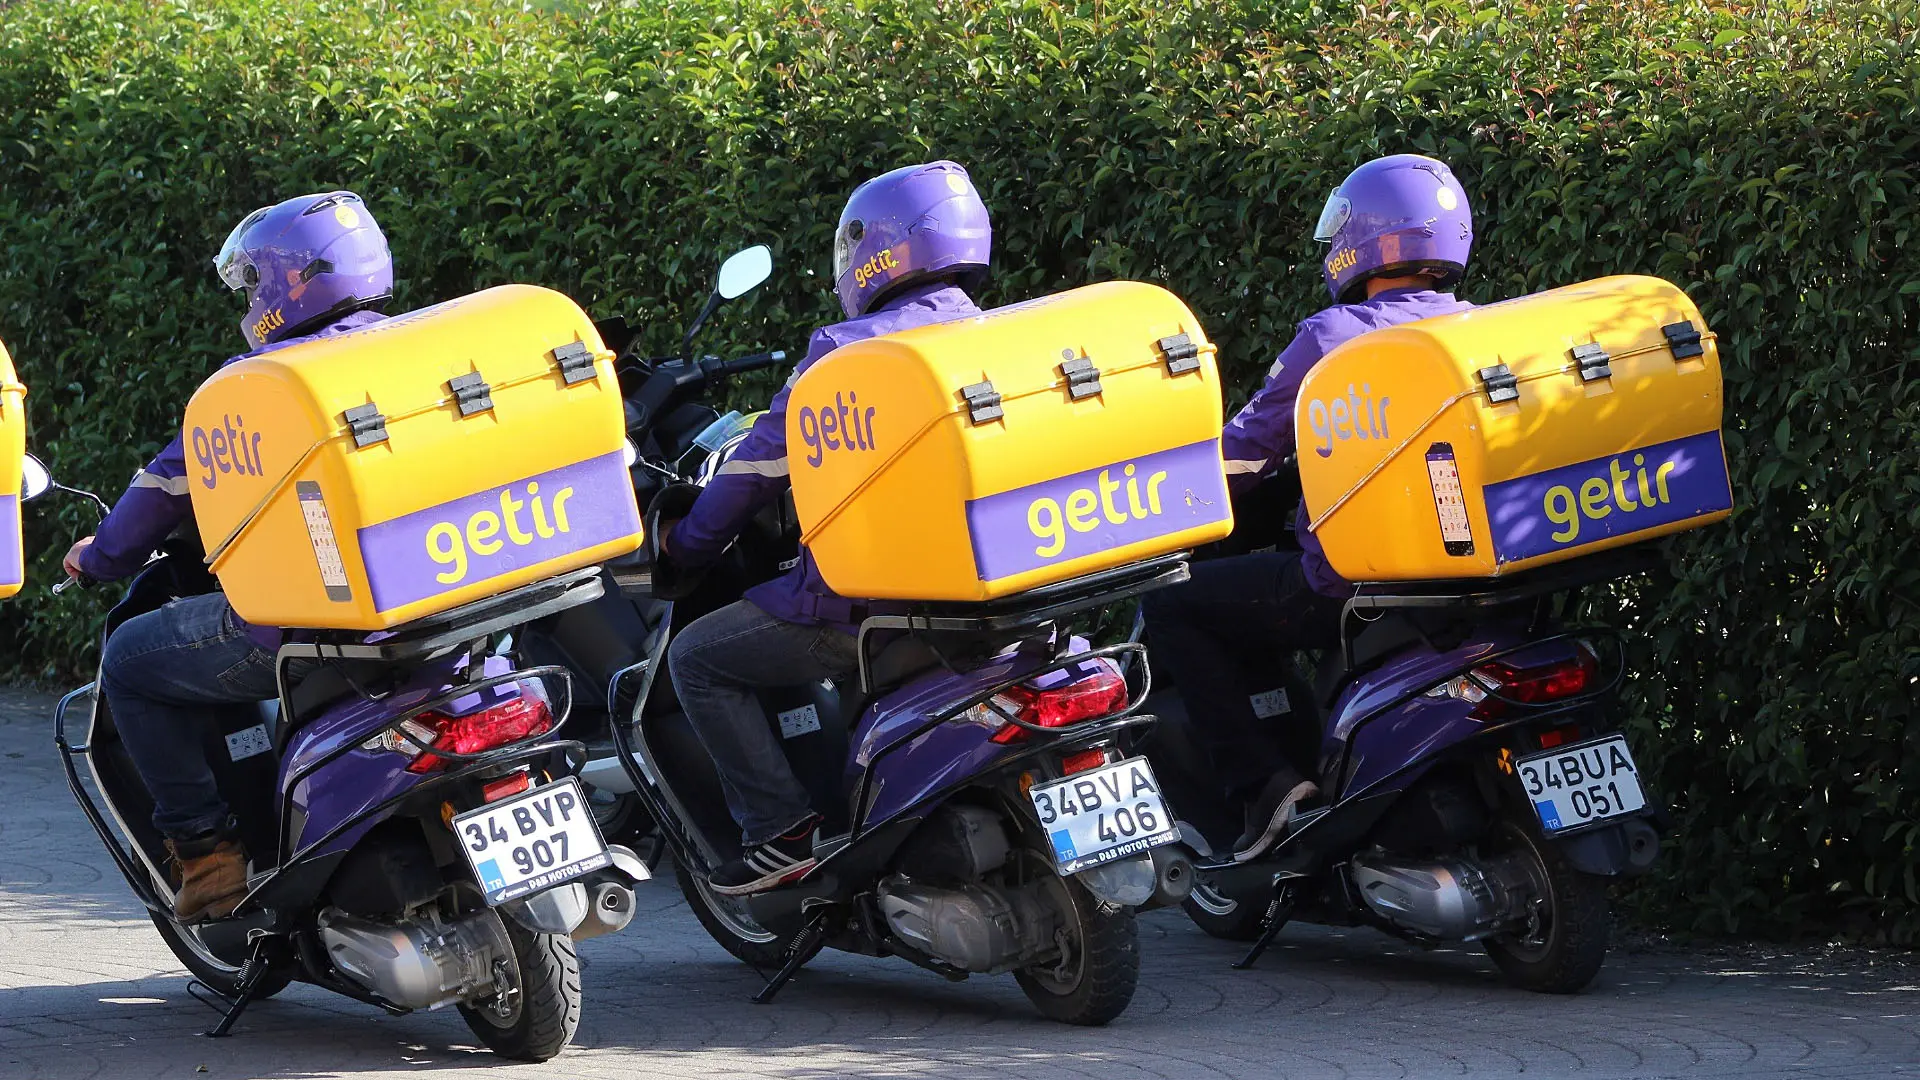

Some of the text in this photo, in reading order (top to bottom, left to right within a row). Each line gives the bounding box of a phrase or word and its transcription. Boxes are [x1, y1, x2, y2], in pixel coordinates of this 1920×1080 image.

[854, 249, 893, 288] getir
[1328, 247, 1357, 280] getir
[252, 309, 285, 343] getir
[799, 390, 876, 468] getir
[1308, 383, 1390, 458] getir
[192, 413, 264, 489] getir
[1027, 463, 1167, 558] getir
[1544, 453, 1675, 543] getir
[425, 481, 574, 584] getir
[1570, 781, 1625, 819] 051
[465, 791, 575, 852] 34 BVP
[1098, 801, 1158, 843] 406
[1546, 819, 1560, 830] TR
[511, 831, 570, 875] 907
[1061, 849, 1075, 862] TR
[1099, 849, 1118, 862] D&B
[1117, 839, 1149, 855] MOTOR
[487, 878, 504, 891] TR
[547, 864, 582, 883] MOTOR
